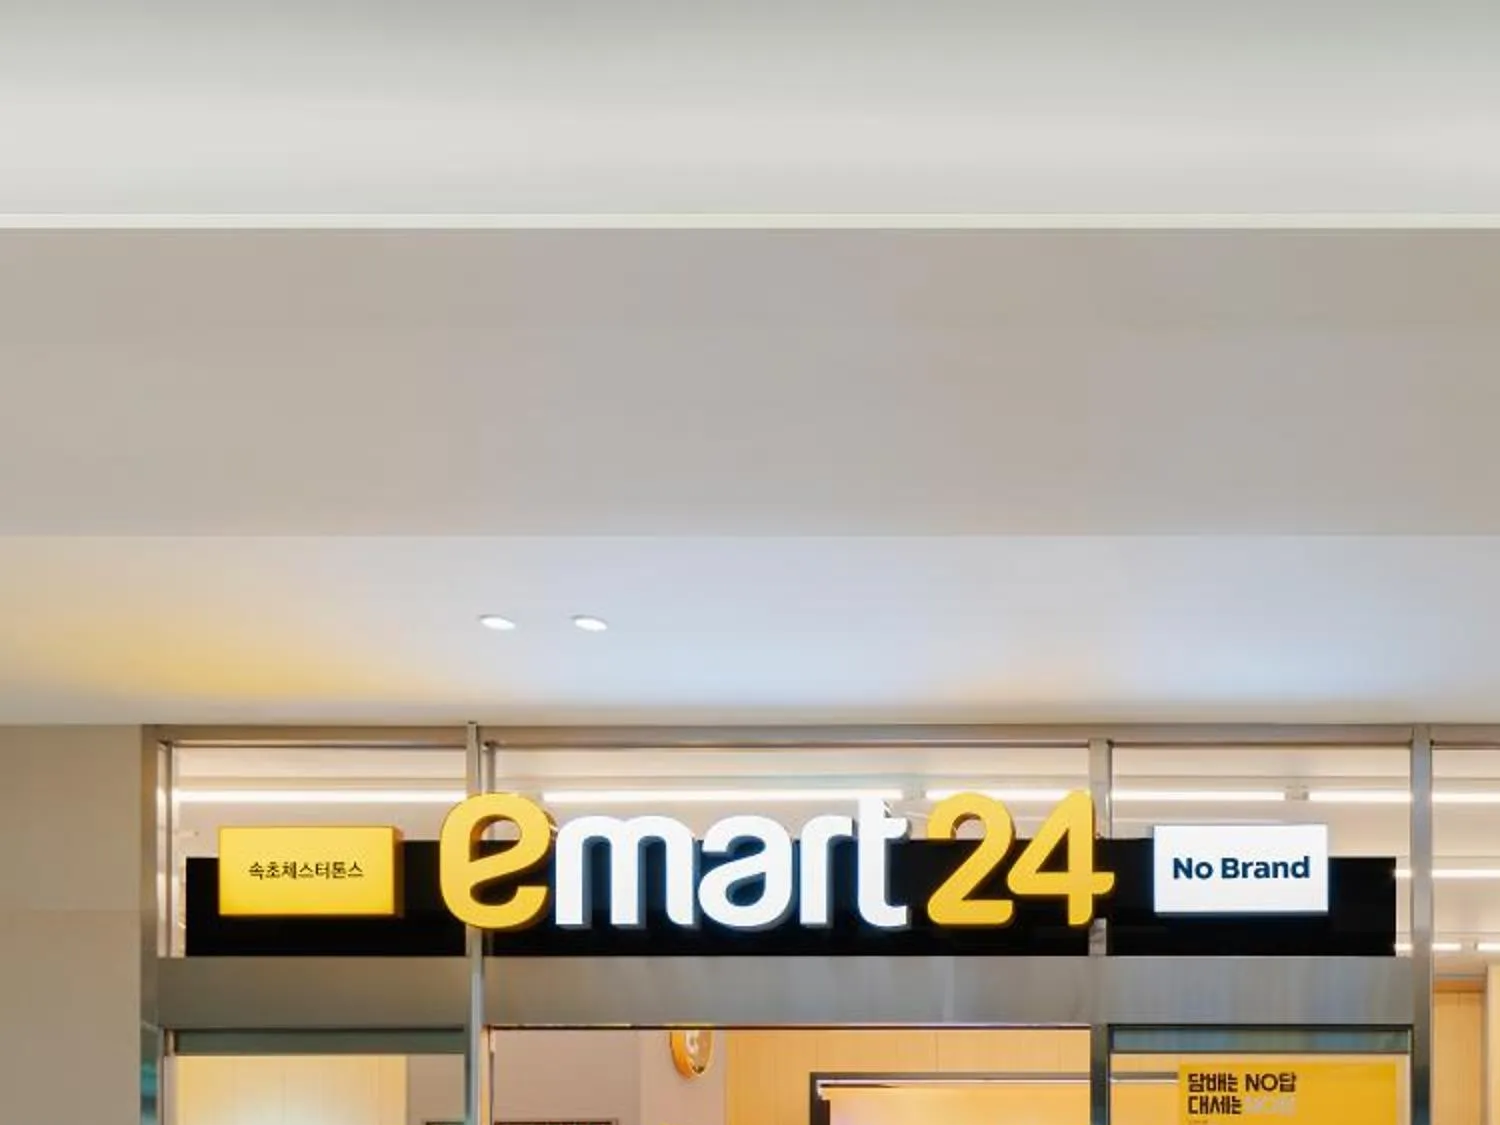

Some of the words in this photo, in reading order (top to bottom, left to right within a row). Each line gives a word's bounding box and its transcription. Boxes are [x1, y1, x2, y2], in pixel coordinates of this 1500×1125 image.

[249, 860, 364, 880] 속초체스터톤스
[1173, 857, 1214, 880] No
[1221, 855, 1311, 880] Brand
[1188, 1072, 1238, 1093] 담배는
[1188, 1095, 1242, 1115] 대세는
